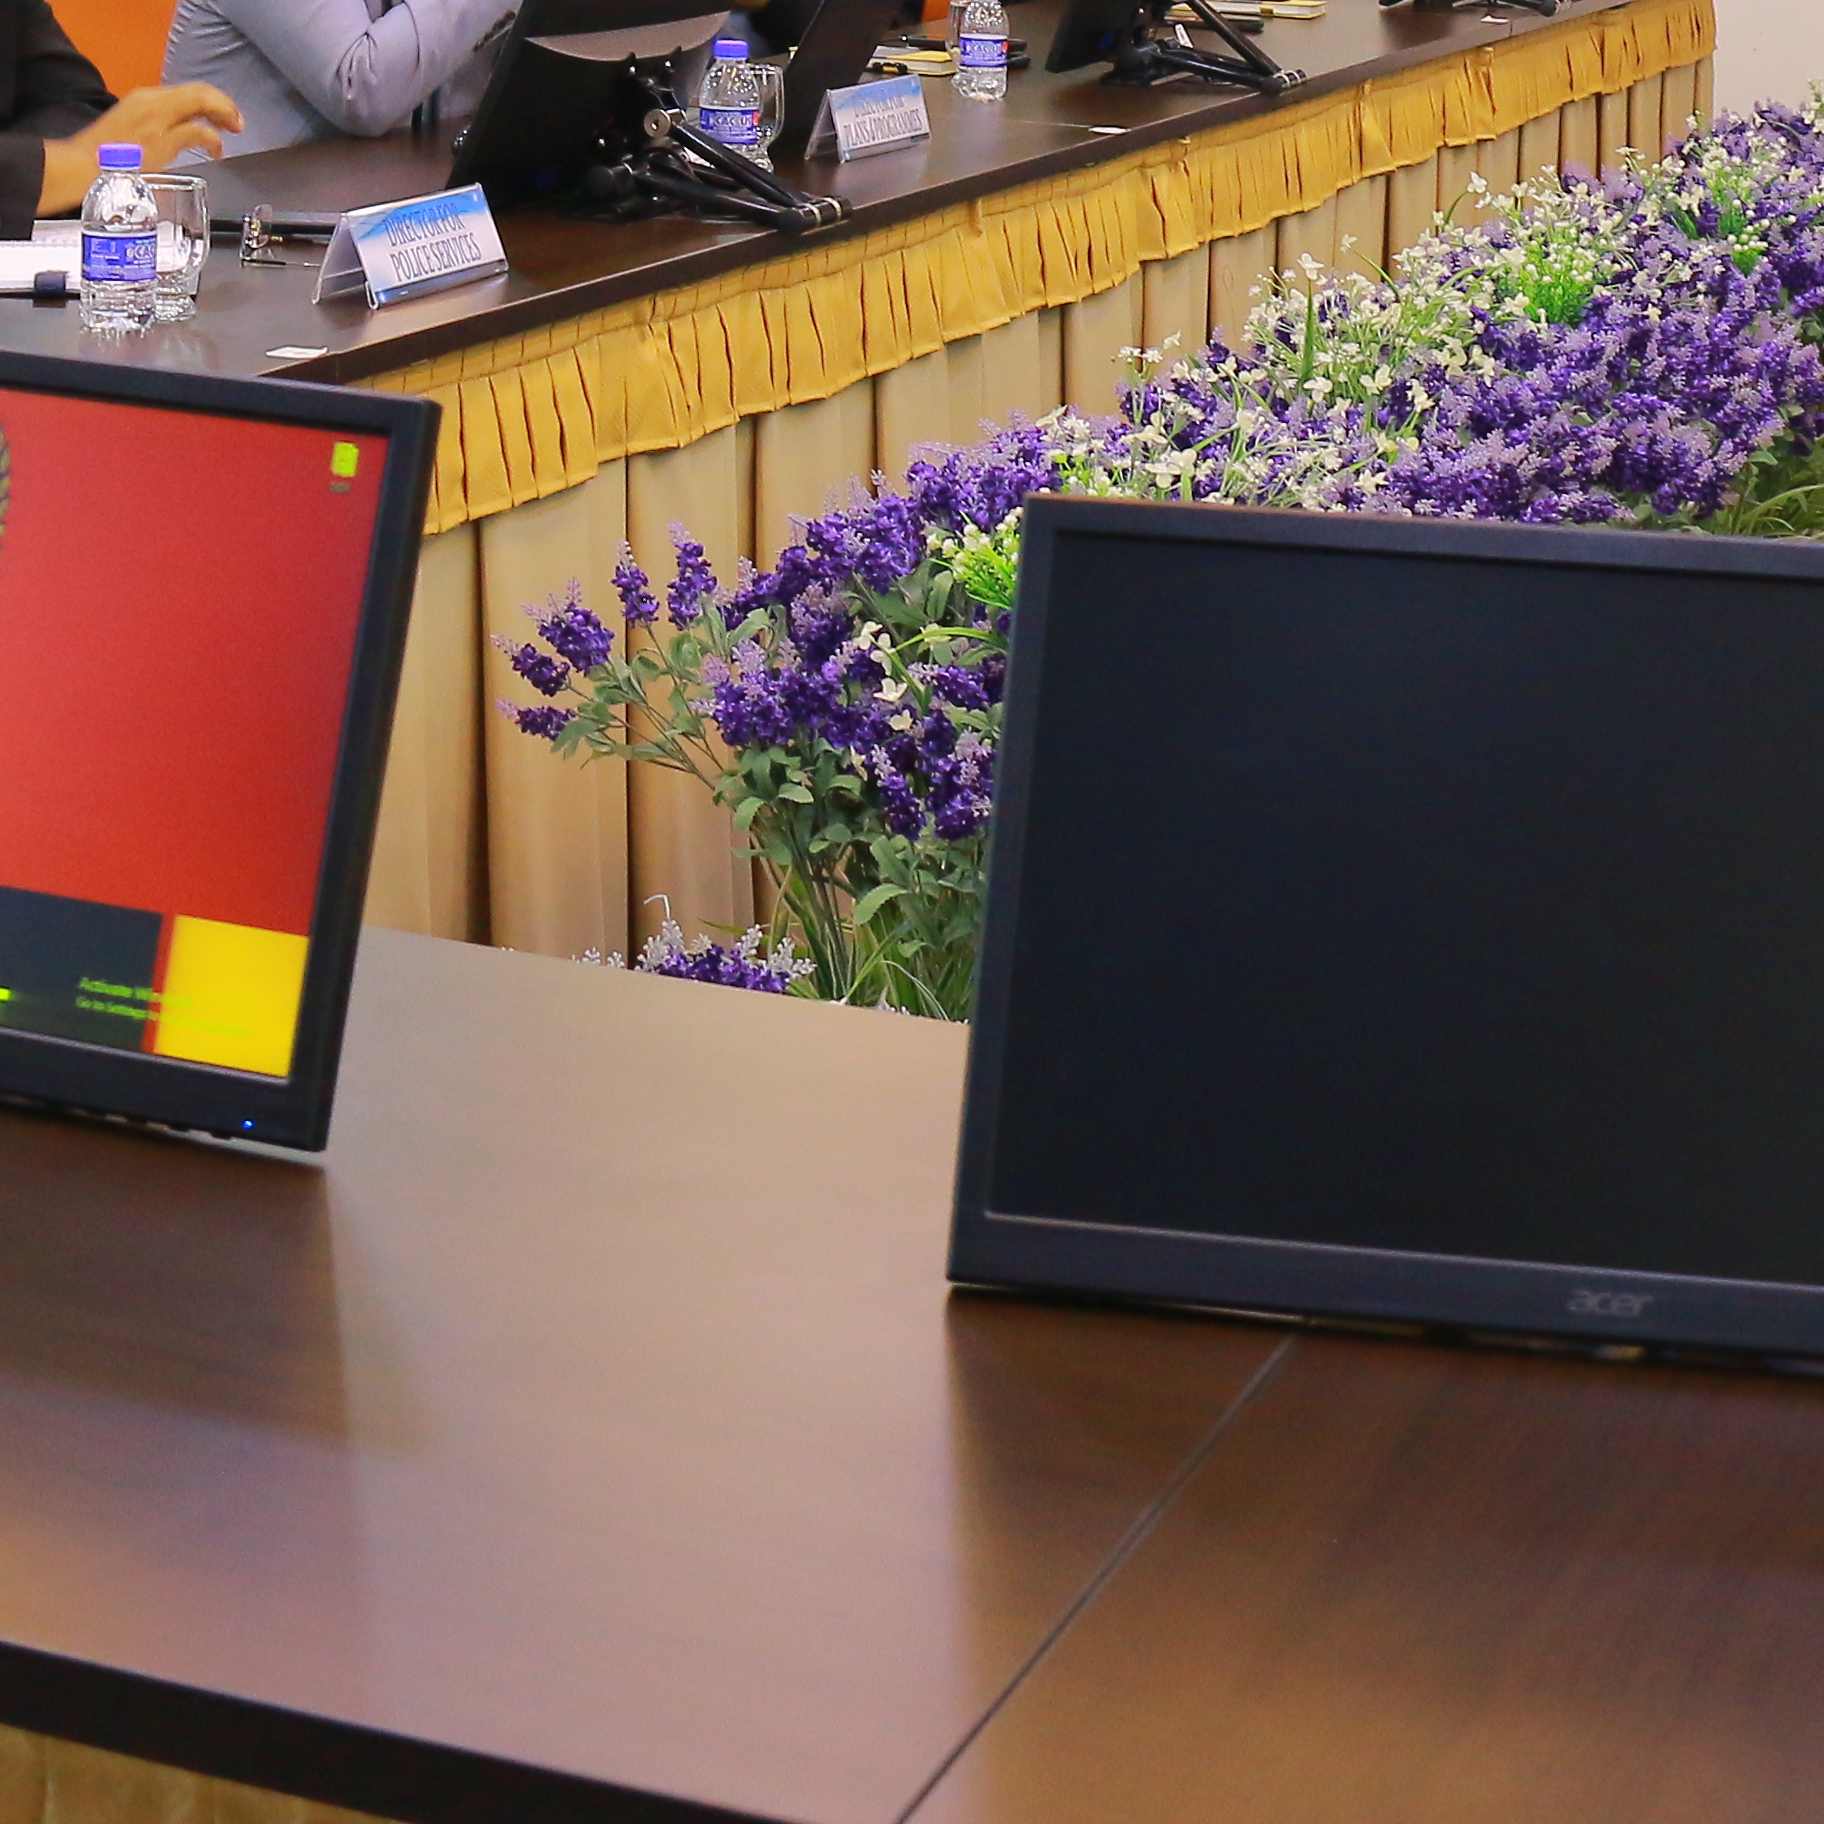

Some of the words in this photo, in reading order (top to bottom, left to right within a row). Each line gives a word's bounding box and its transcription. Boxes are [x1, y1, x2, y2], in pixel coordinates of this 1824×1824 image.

[383, 207, 441, 247] DIRECTOR
[438, 202, 466, 232] FOR
[389, 244, 435, 282] POLICE
[433, 232, 482, 272] SERVICES
[1565, 1288, 1655, 1318] acer
